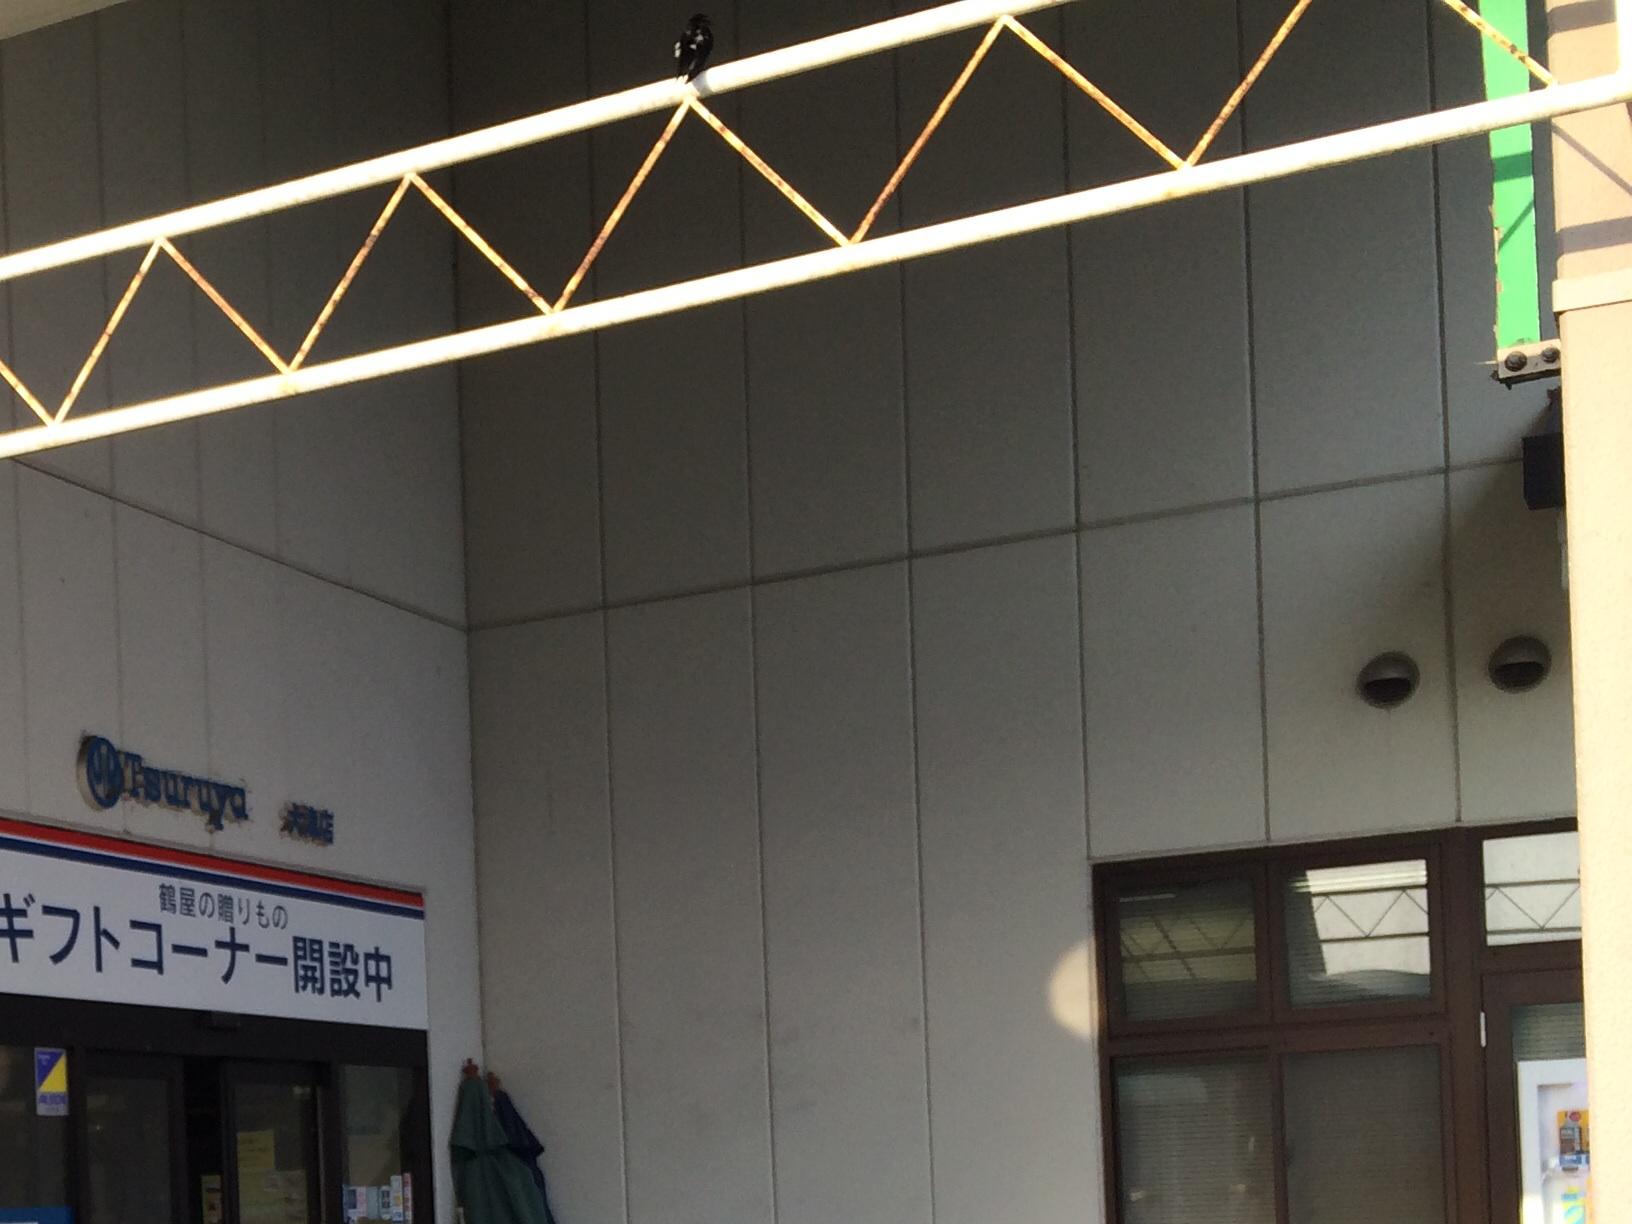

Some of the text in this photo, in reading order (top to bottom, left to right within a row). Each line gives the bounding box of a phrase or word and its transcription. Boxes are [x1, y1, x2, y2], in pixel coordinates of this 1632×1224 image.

[118, 749, 248, 831] Tsuruya
[159, 883, 288, 930] 鶴屋の贈りもの
